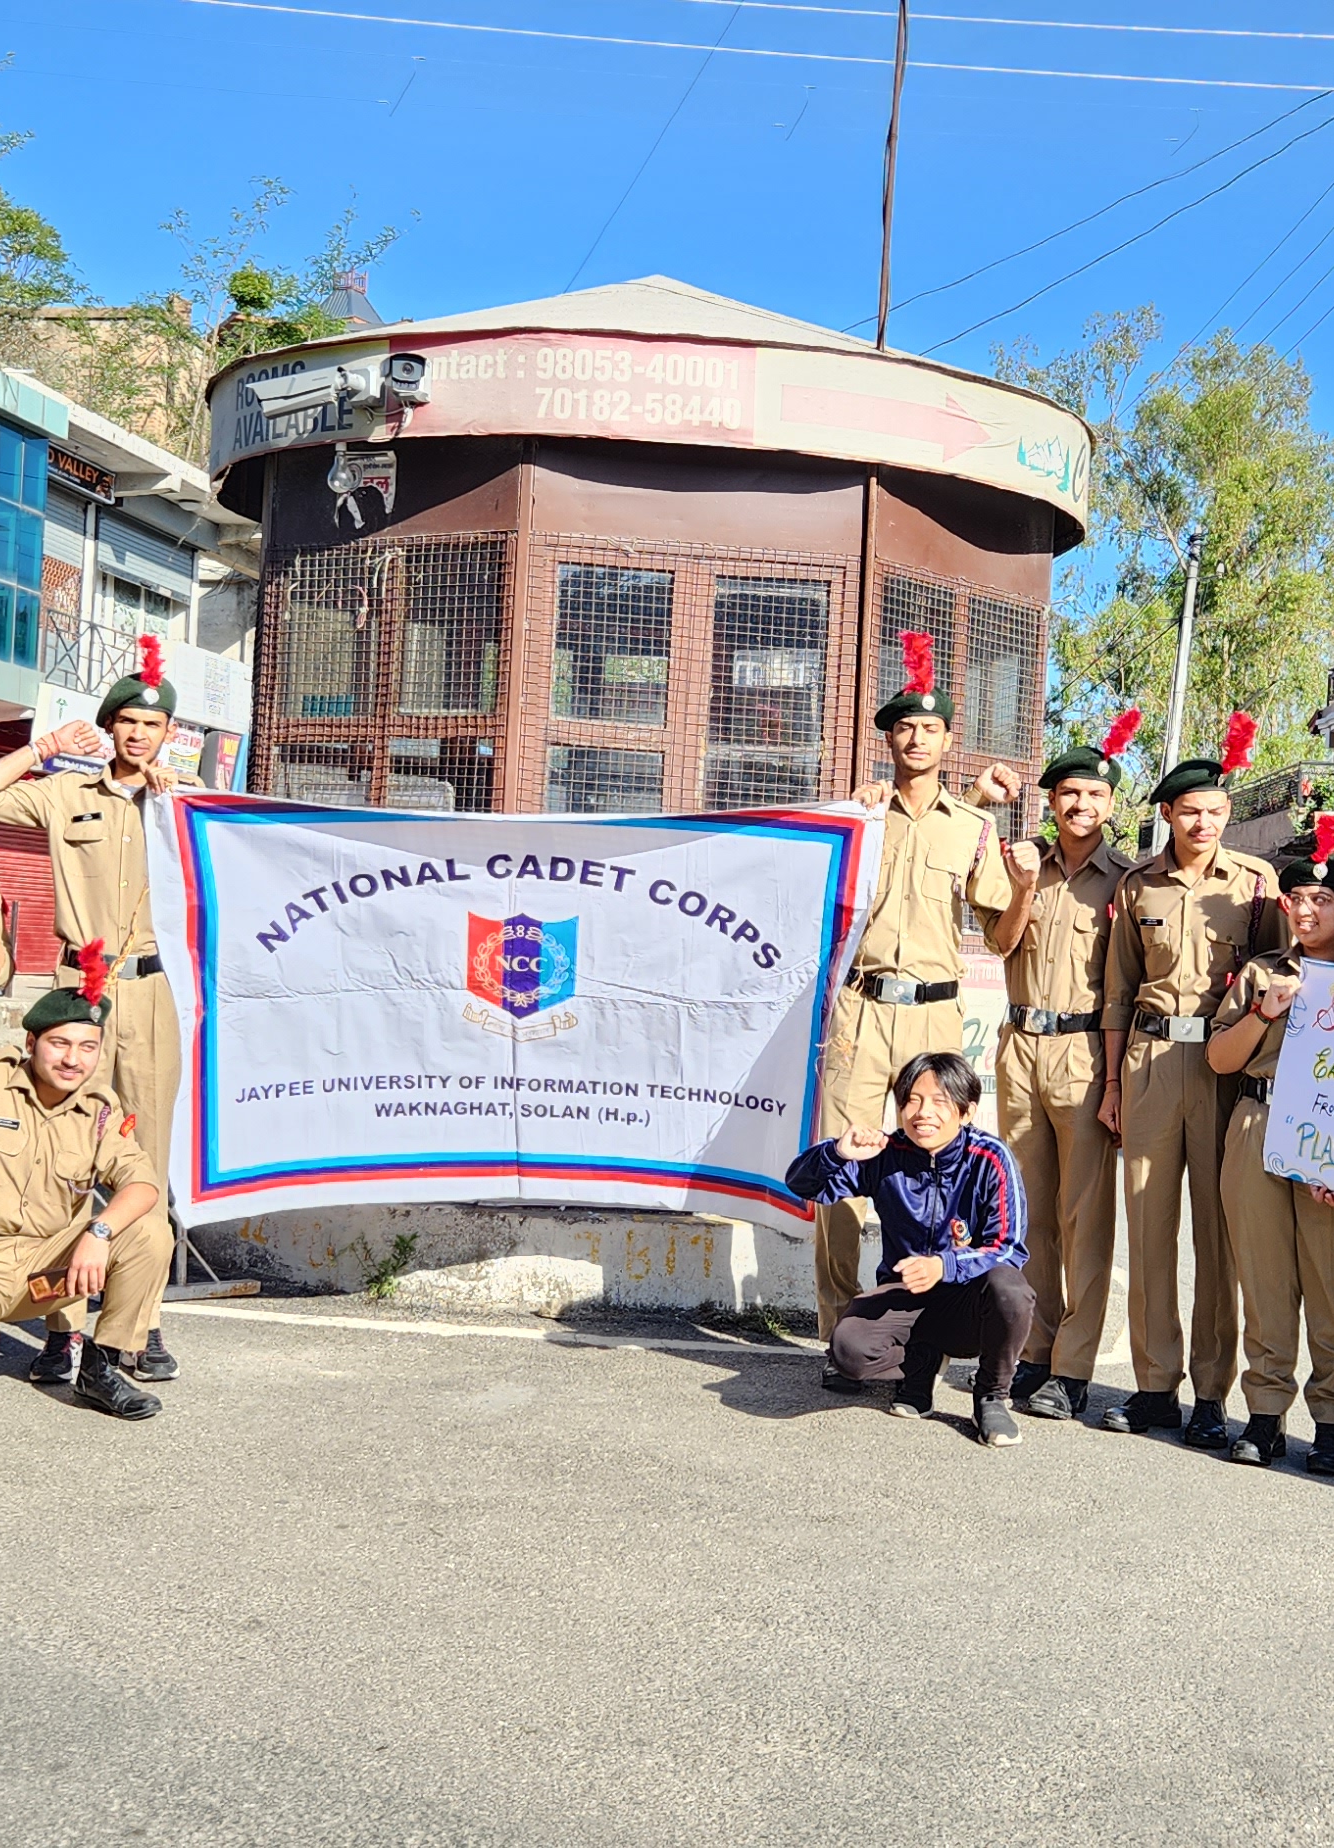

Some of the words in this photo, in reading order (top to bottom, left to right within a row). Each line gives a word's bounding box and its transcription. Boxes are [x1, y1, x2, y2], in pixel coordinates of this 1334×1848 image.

[432, 350, 506, 380] ntact
[535, 347, 741, 390] 98053-40001
[233, 392, 353, 450] AVAILABLE
[534, 387, 742, 430] 70182-58440
[58, 452, 99, 484] VALLEY
[256, 857, 471, 954] NATIONAL
[486, 853, 636, 893] CADET
[648, 878, 782, 970] CORPS
[494, 954, 546, 973] NCC
[235, 1080, 315, 1104] JAYPEE
[322, 1074, 453, 1093] UNIVERSITY
[458, 1075, 487, 1090] OF
[493, 1076, 639, 1097] INFORMATION
[646, 1083, 787, 1117] TECHNOLOGY
[375, 1101, 514, 1119] WAKNAGHAT,
[520, 1103, 590, 1120] SOLAN
[597, 1106, 651, 1127] (H.p.)
